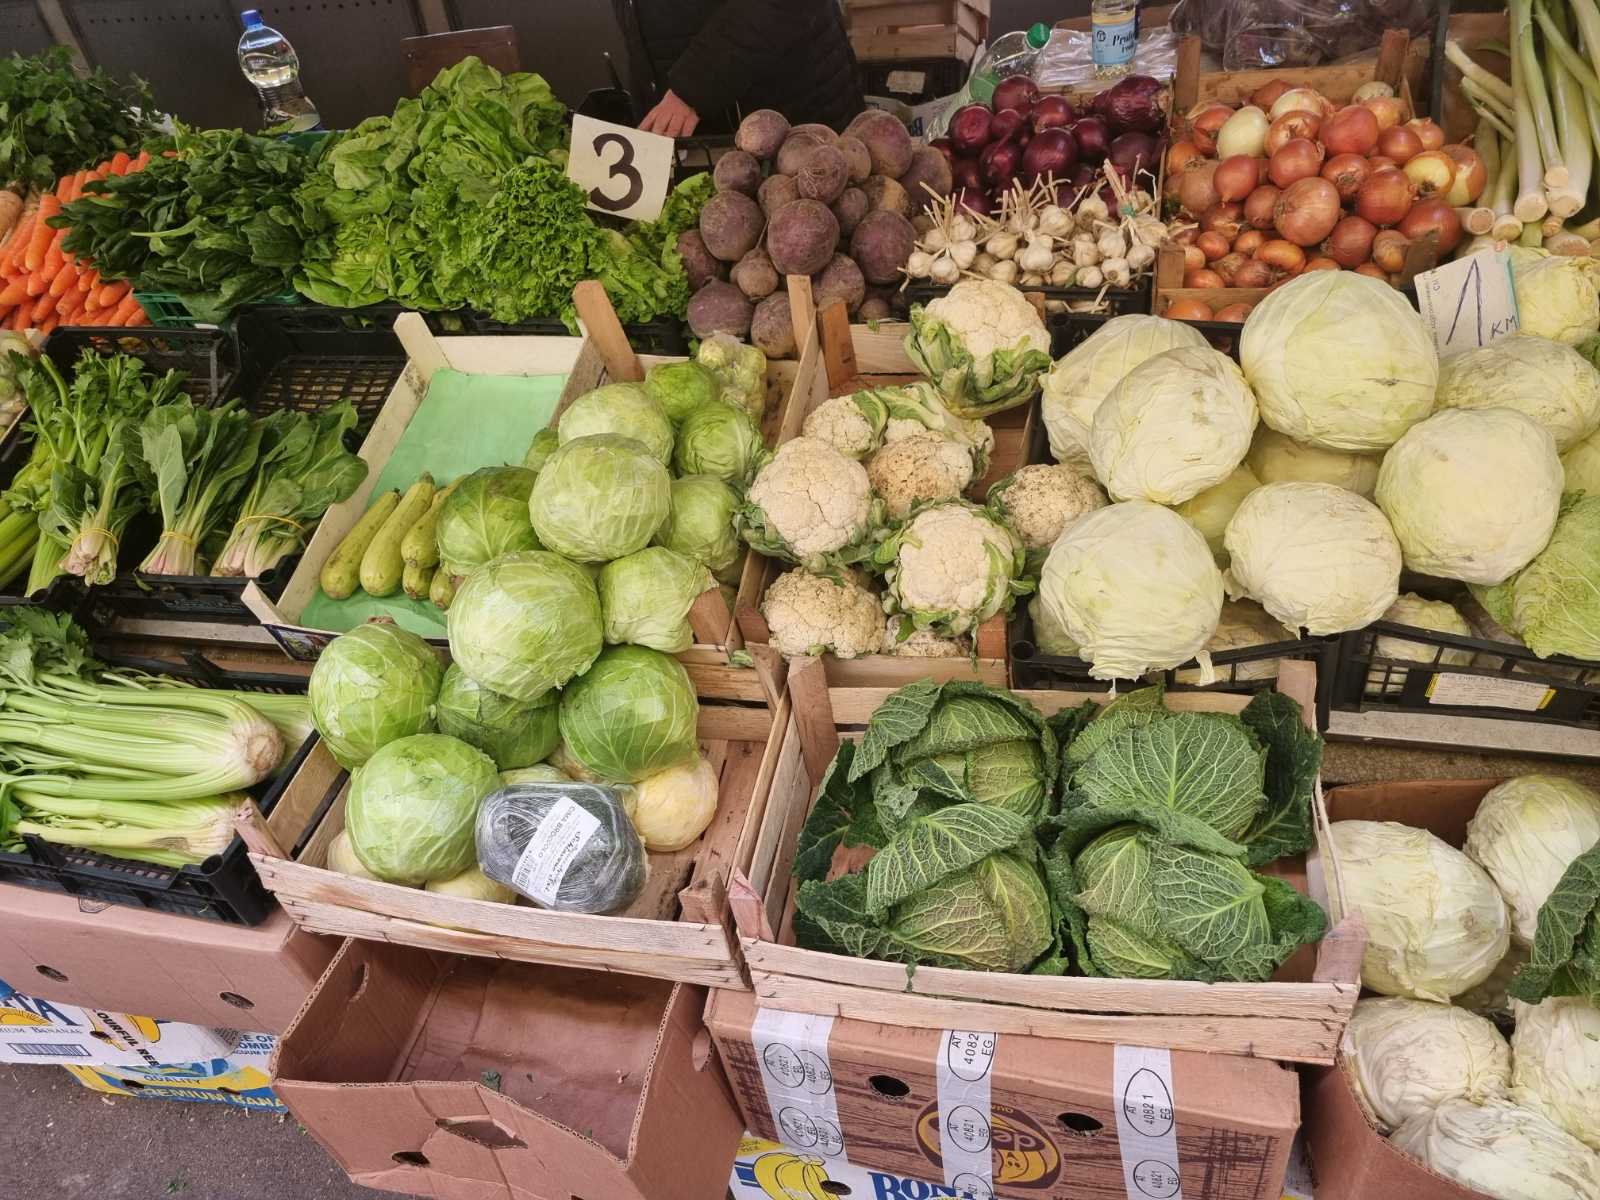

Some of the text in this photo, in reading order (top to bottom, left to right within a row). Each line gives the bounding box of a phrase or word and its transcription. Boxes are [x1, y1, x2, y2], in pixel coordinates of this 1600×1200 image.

[590, 133, 643, 211] 3
[1445, 258, 1483, 346] 1
[1491, 314, 1519, 339] KM
[94, 1009, 139, 1047] OURFUL
[952, 1035, 962, 1048] AT
[981, 1039, 993, 1057] EG
[143, 1075, 201, 1085] QUALITY
[1160, 1107, 1172, 1120] EG
